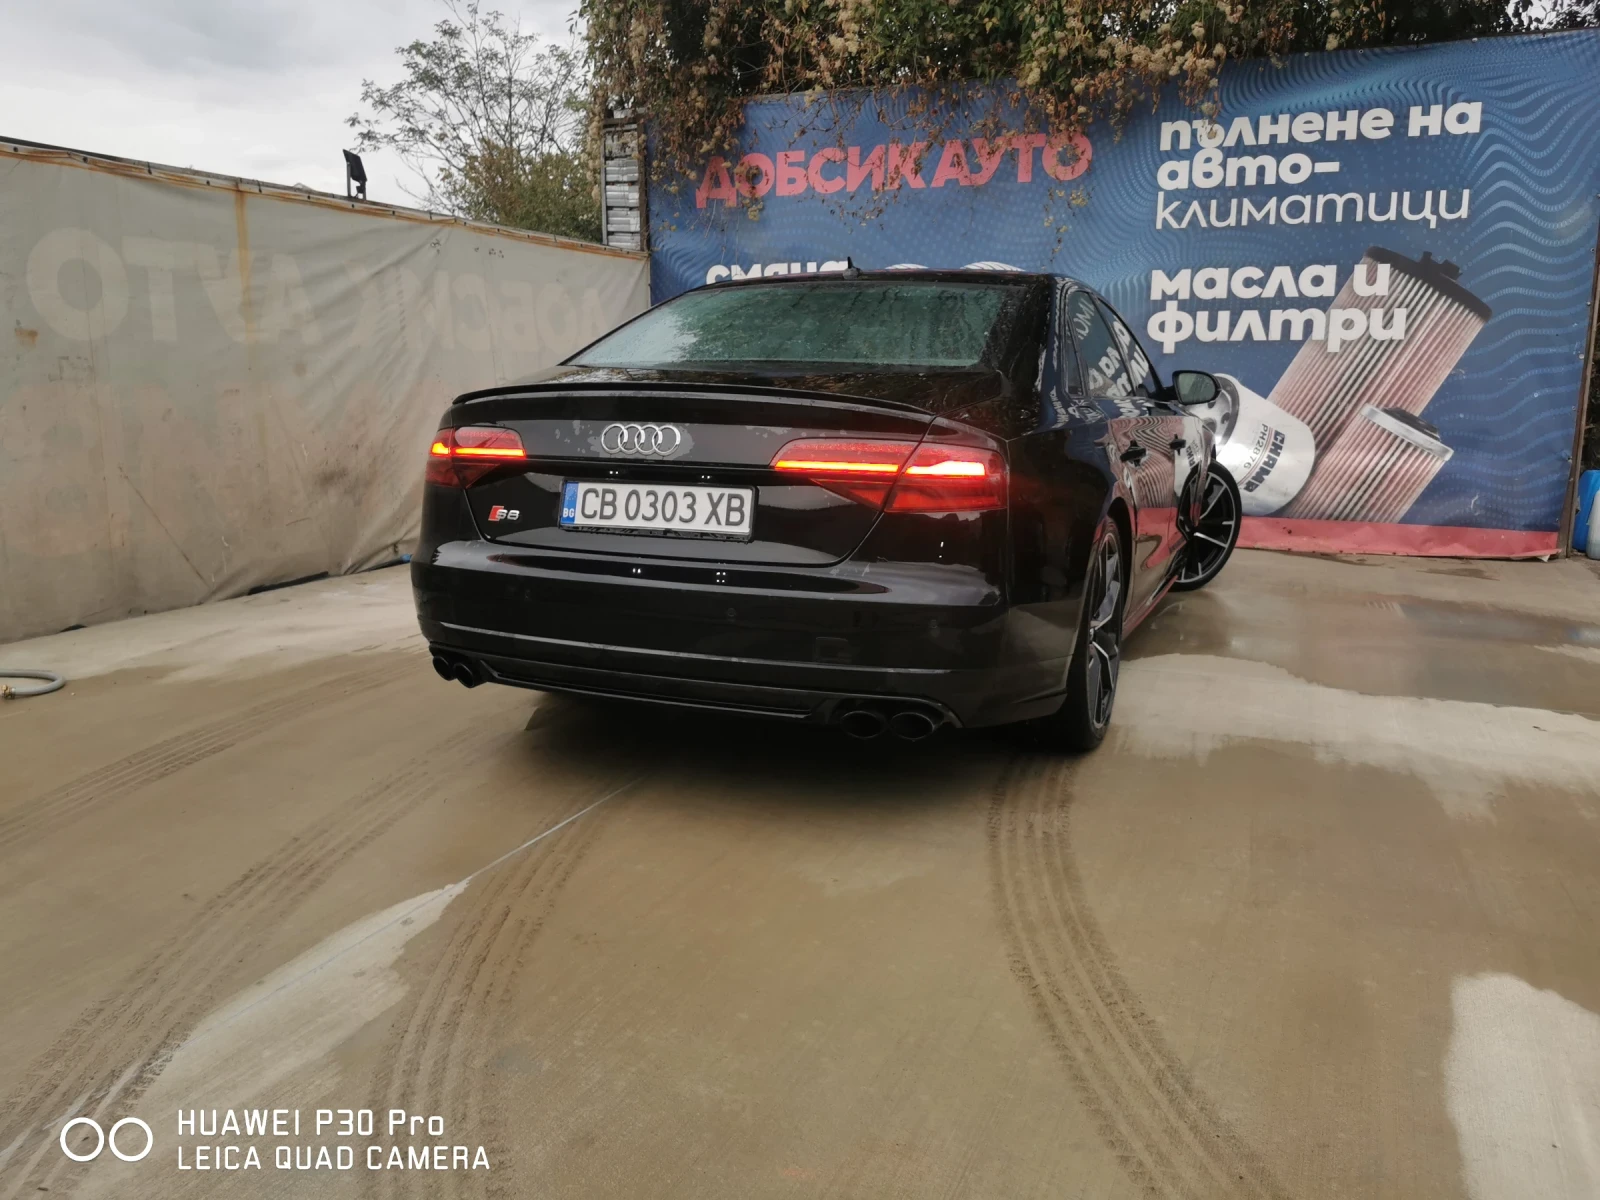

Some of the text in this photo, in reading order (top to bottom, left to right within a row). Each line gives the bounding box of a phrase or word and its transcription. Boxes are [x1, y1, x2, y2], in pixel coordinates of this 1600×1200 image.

[1159, 101, 1482, 151] пълнене на
[696, 130, 1093, 208] ДОБСИК АУТО
[1156, 149, 1341, 191] авто-
[1155, 189, 1470, 230] климатици
[1150, 263, 1391, 301] масла и
[1147, 300, 1407, 354] филтри
[1242, 429, 1286, 493] CHAMP
[494, 507, 520, 521] S8
[562, 507, 575, 518] BG
[580, 488, 746, 527] CB 0303 XB
